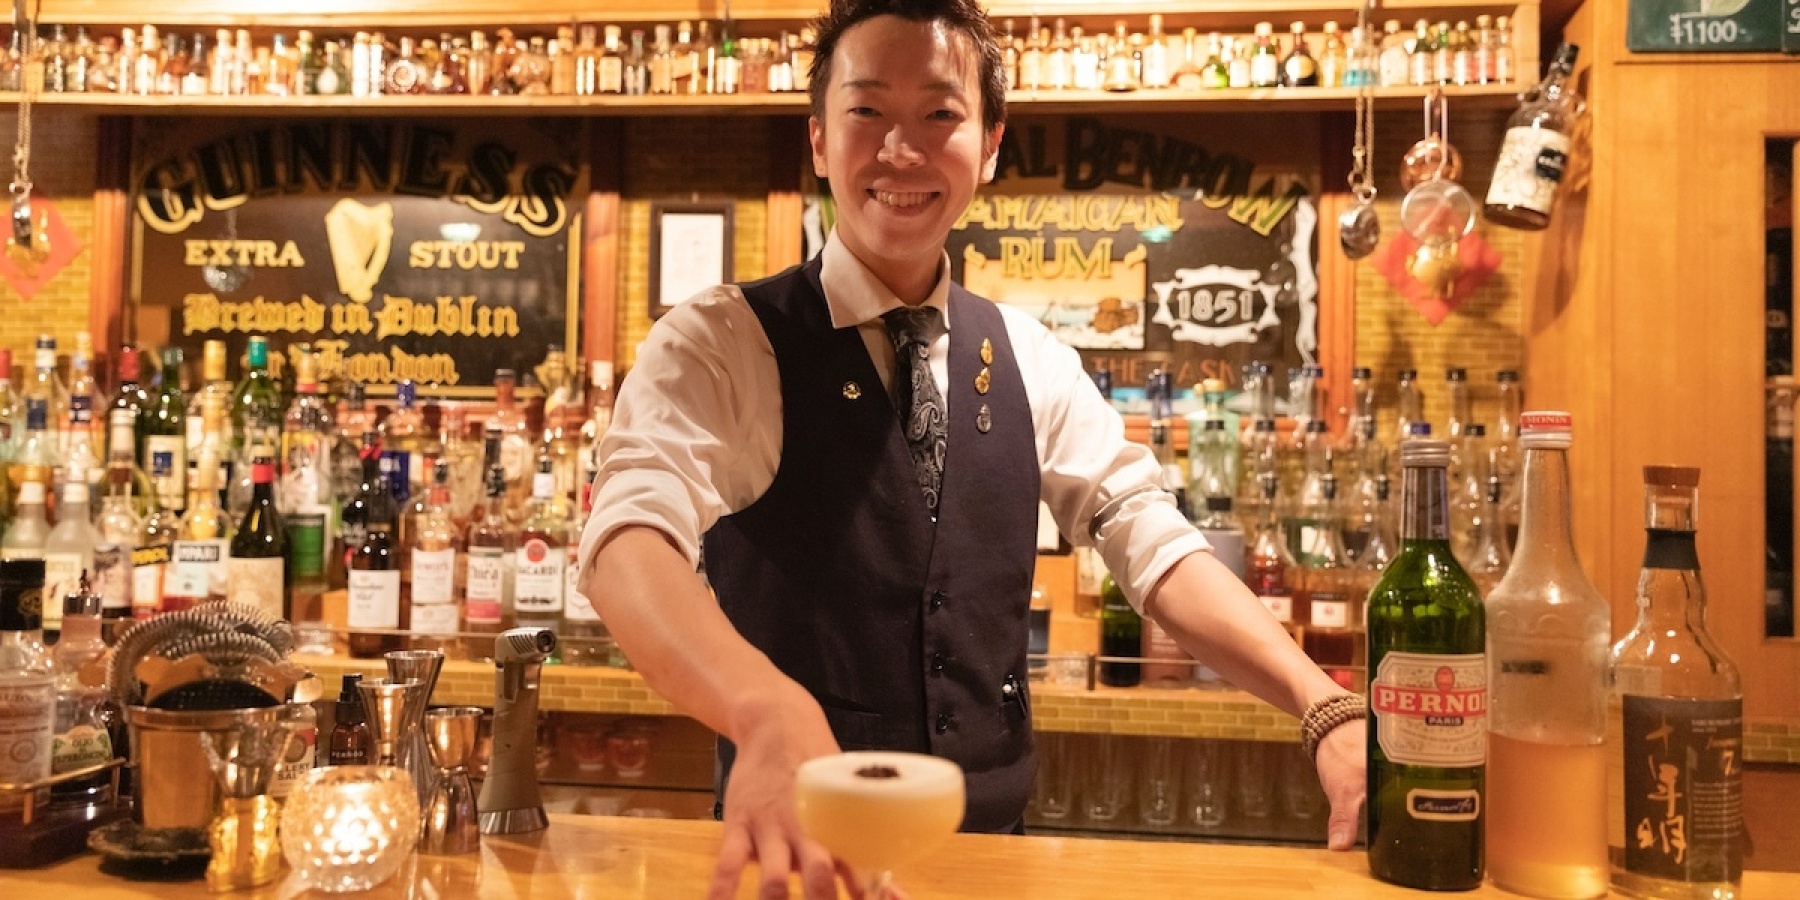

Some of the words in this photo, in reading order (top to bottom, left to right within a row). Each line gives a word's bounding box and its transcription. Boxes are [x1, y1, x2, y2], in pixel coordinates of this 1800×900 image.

[137, 119, 577, 236] GUINNESS
[951, 194, 1184, 231] AMAICAN
[183, 239, 305, 267] EXTRA
[409, 239, 526, 270] STOUT
[999, 236, 1113, 279] RUM
[182, 293, 326, 337] Brewed
[330, 302, 373, 335] in
[373, 294, 520, 342] Dublin
[1176, 288, 1254, 324] 1851
[1156, 358, 1236, 385] ASK
[1428, 717, 1463, 726] PARIS
